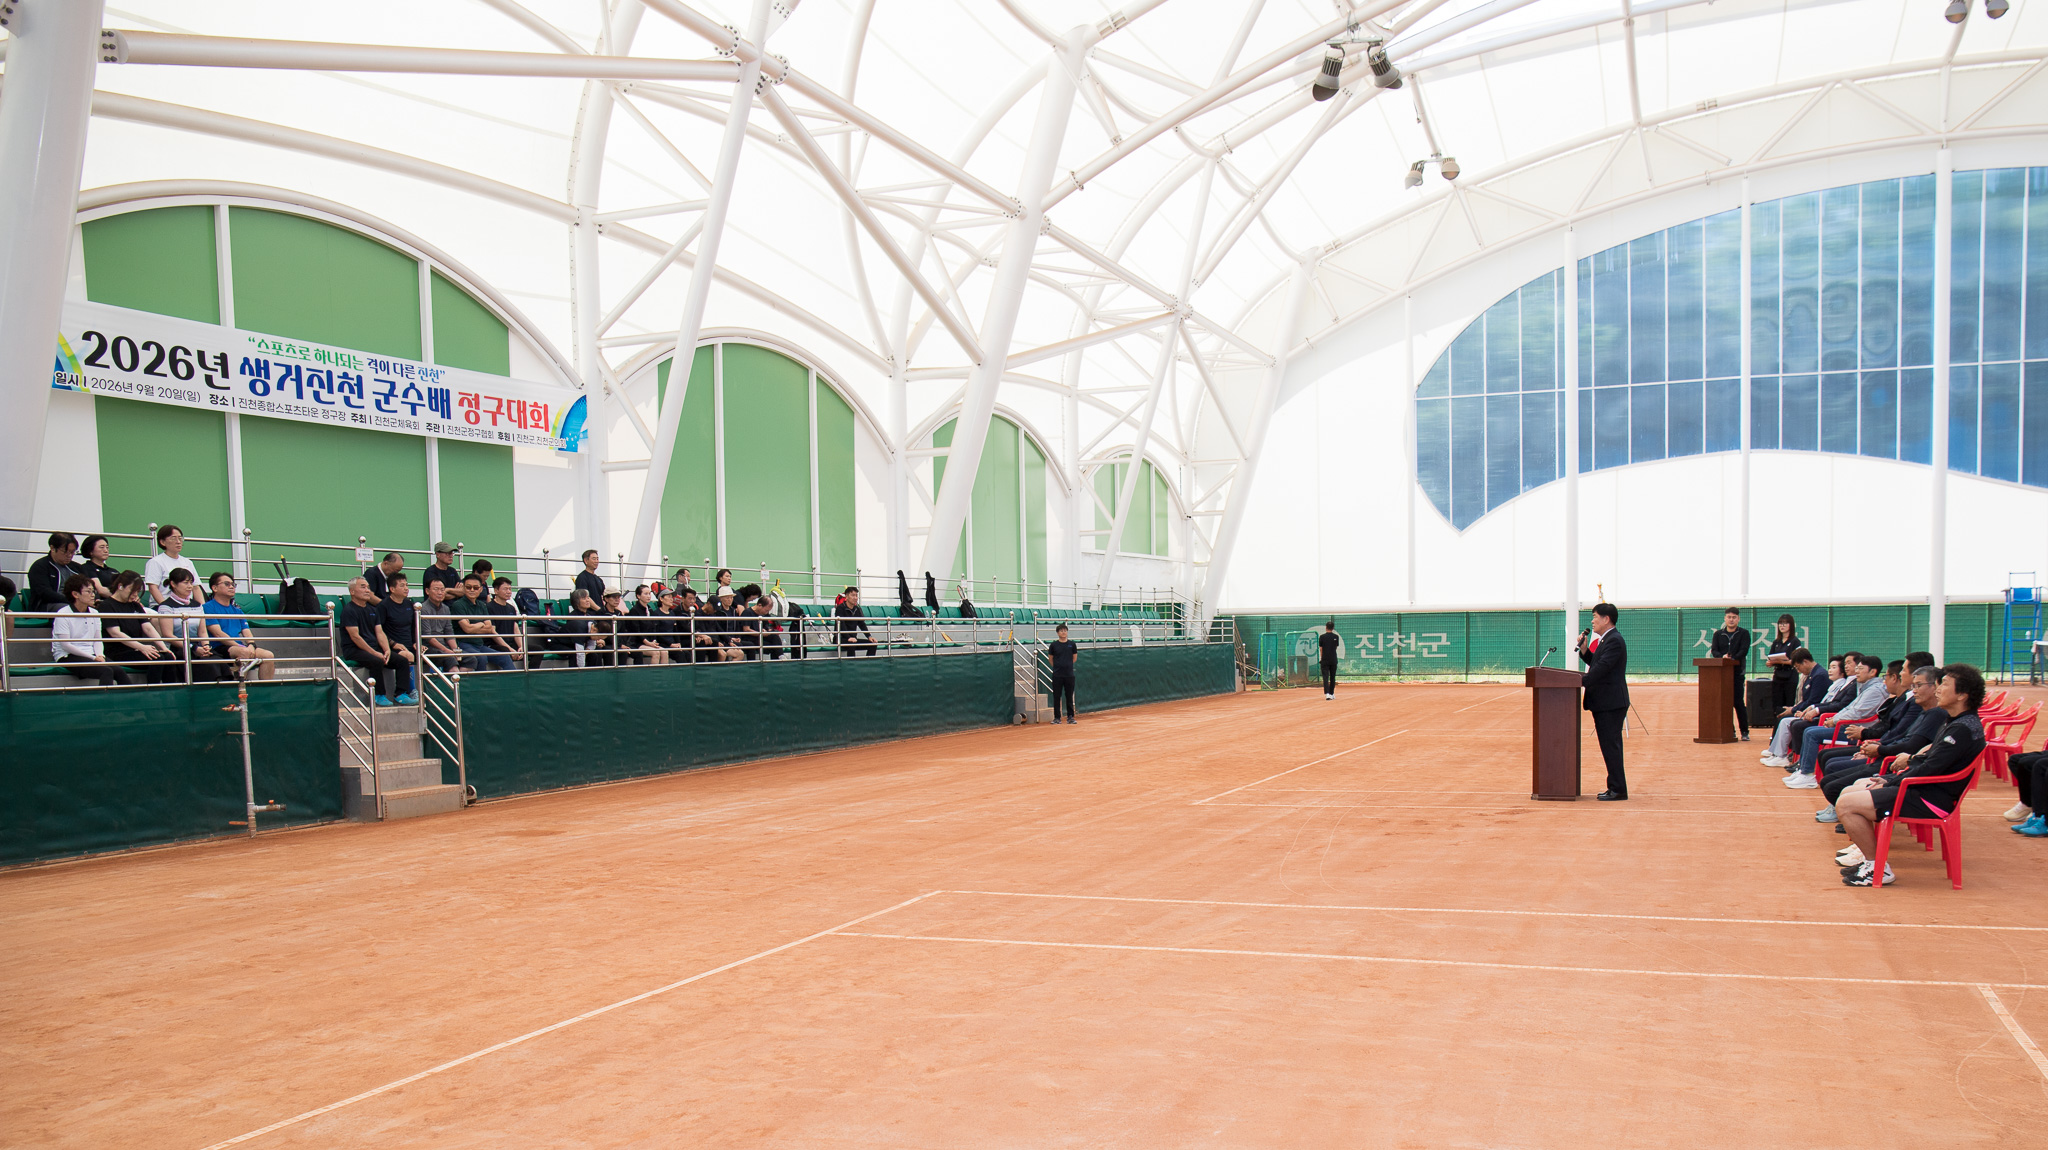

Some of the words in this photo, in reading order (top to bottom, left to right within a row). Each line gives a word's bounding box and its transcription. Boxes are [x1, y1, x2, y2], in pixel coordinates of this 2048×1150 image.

[81, 330, 231, 390] 2026년
[239, 356, 365, 409] 생거진천
[372, 377, 452, 420] 군수배
[458, 391, 550, 432] 정구대회
[314, 348, 364, 371] 하나되는
[366, 357, 391, 375] 격이
[393, 362, 416, 380] 다른
[55, 371, 79, 387] 일시
[91, 377, 133, 394] 2026년
[136, 383, 155, 396] 9월
[157, 386, 201, 403] 20일(일)
[208, 393, 230, 407] 장소
[238, 397, 319, 418] 진천종합스포츠타운
[321, 408, 347, 421] 정구장
[350, 412, 367, 424] 주최
[374, 415, 420, 431] 진천군체육회
[425, 422, 441, 433] 주관
[447, 425, 495, 440] 진천군정구협회
[1354, 631, 1450, 659] 진천군
